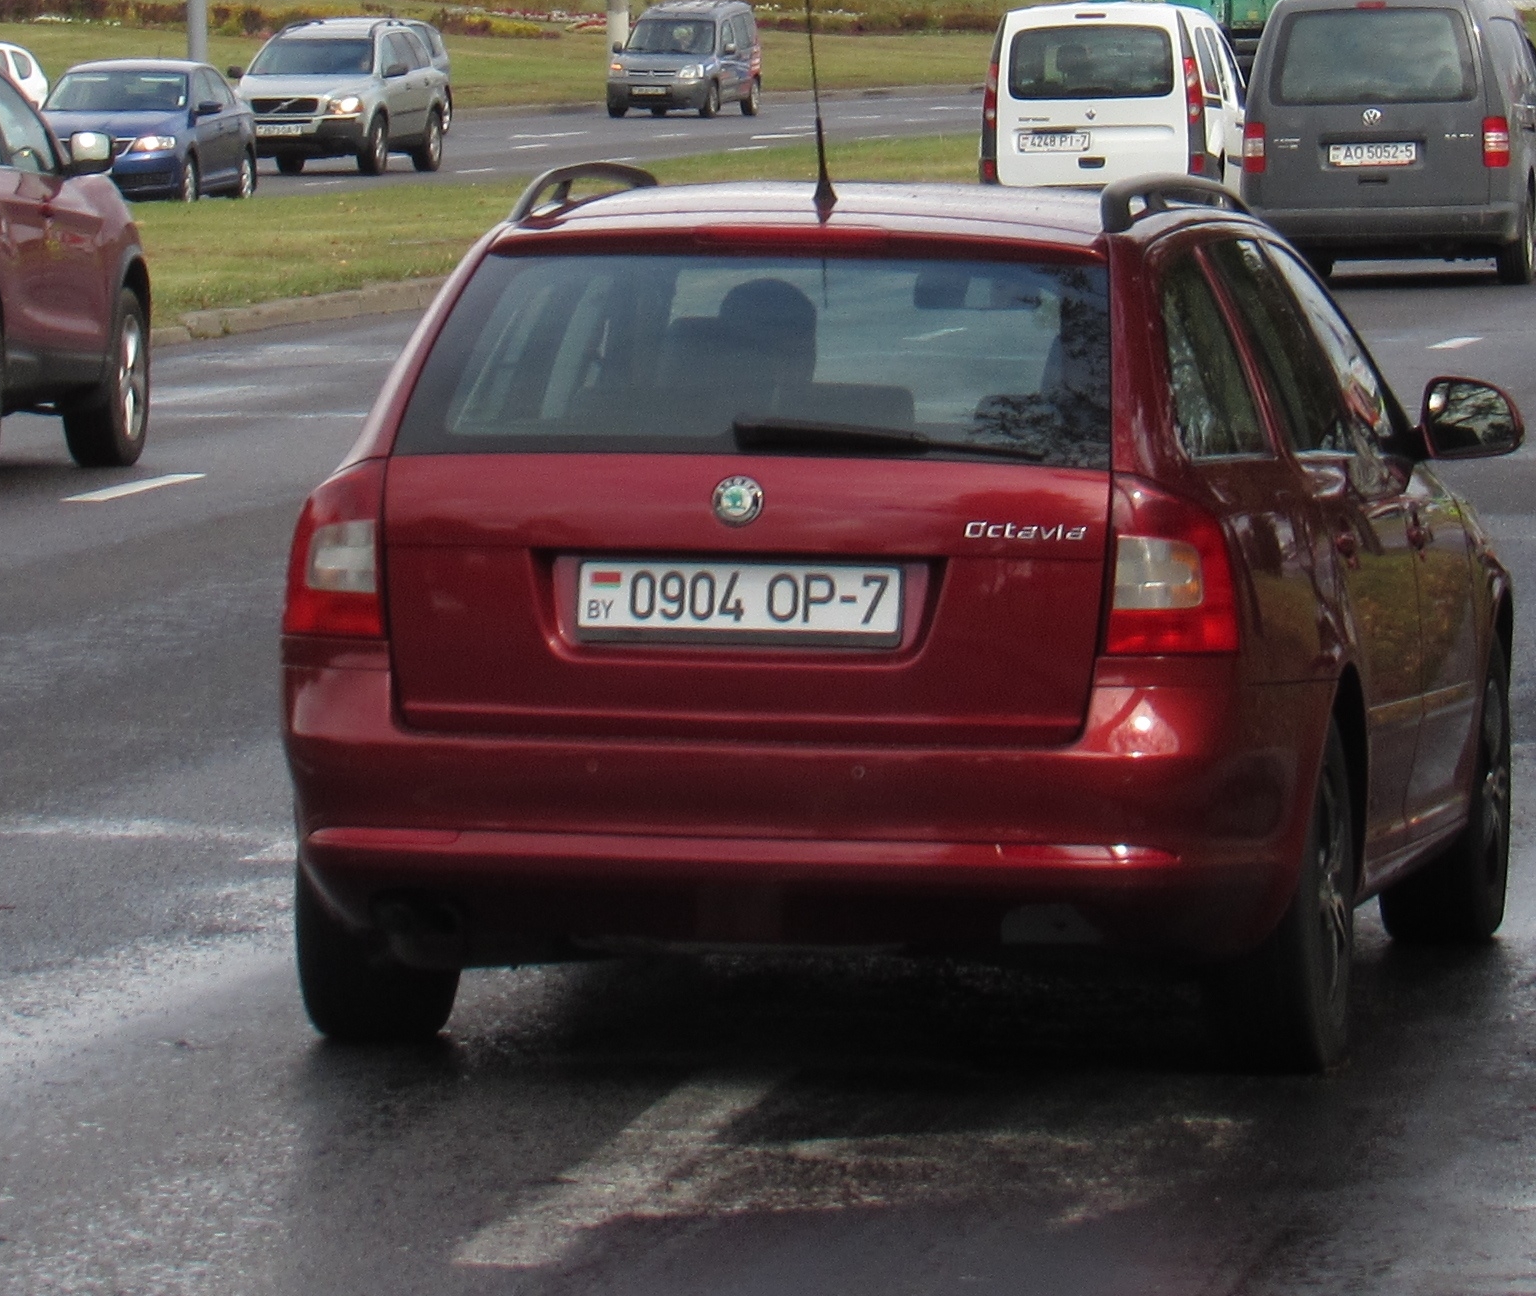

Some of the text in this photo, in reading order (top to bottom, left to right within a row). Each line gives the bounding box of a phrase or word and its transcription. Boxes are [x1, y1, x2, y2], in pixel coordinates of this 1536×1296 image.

[1343, 144, 1413, 160] AO 5052-5
[964, 521, 1087, 541] Octavia
[629, 570, 890, 625] 0904 OP-7
[587, 599, 614, 619] BY
